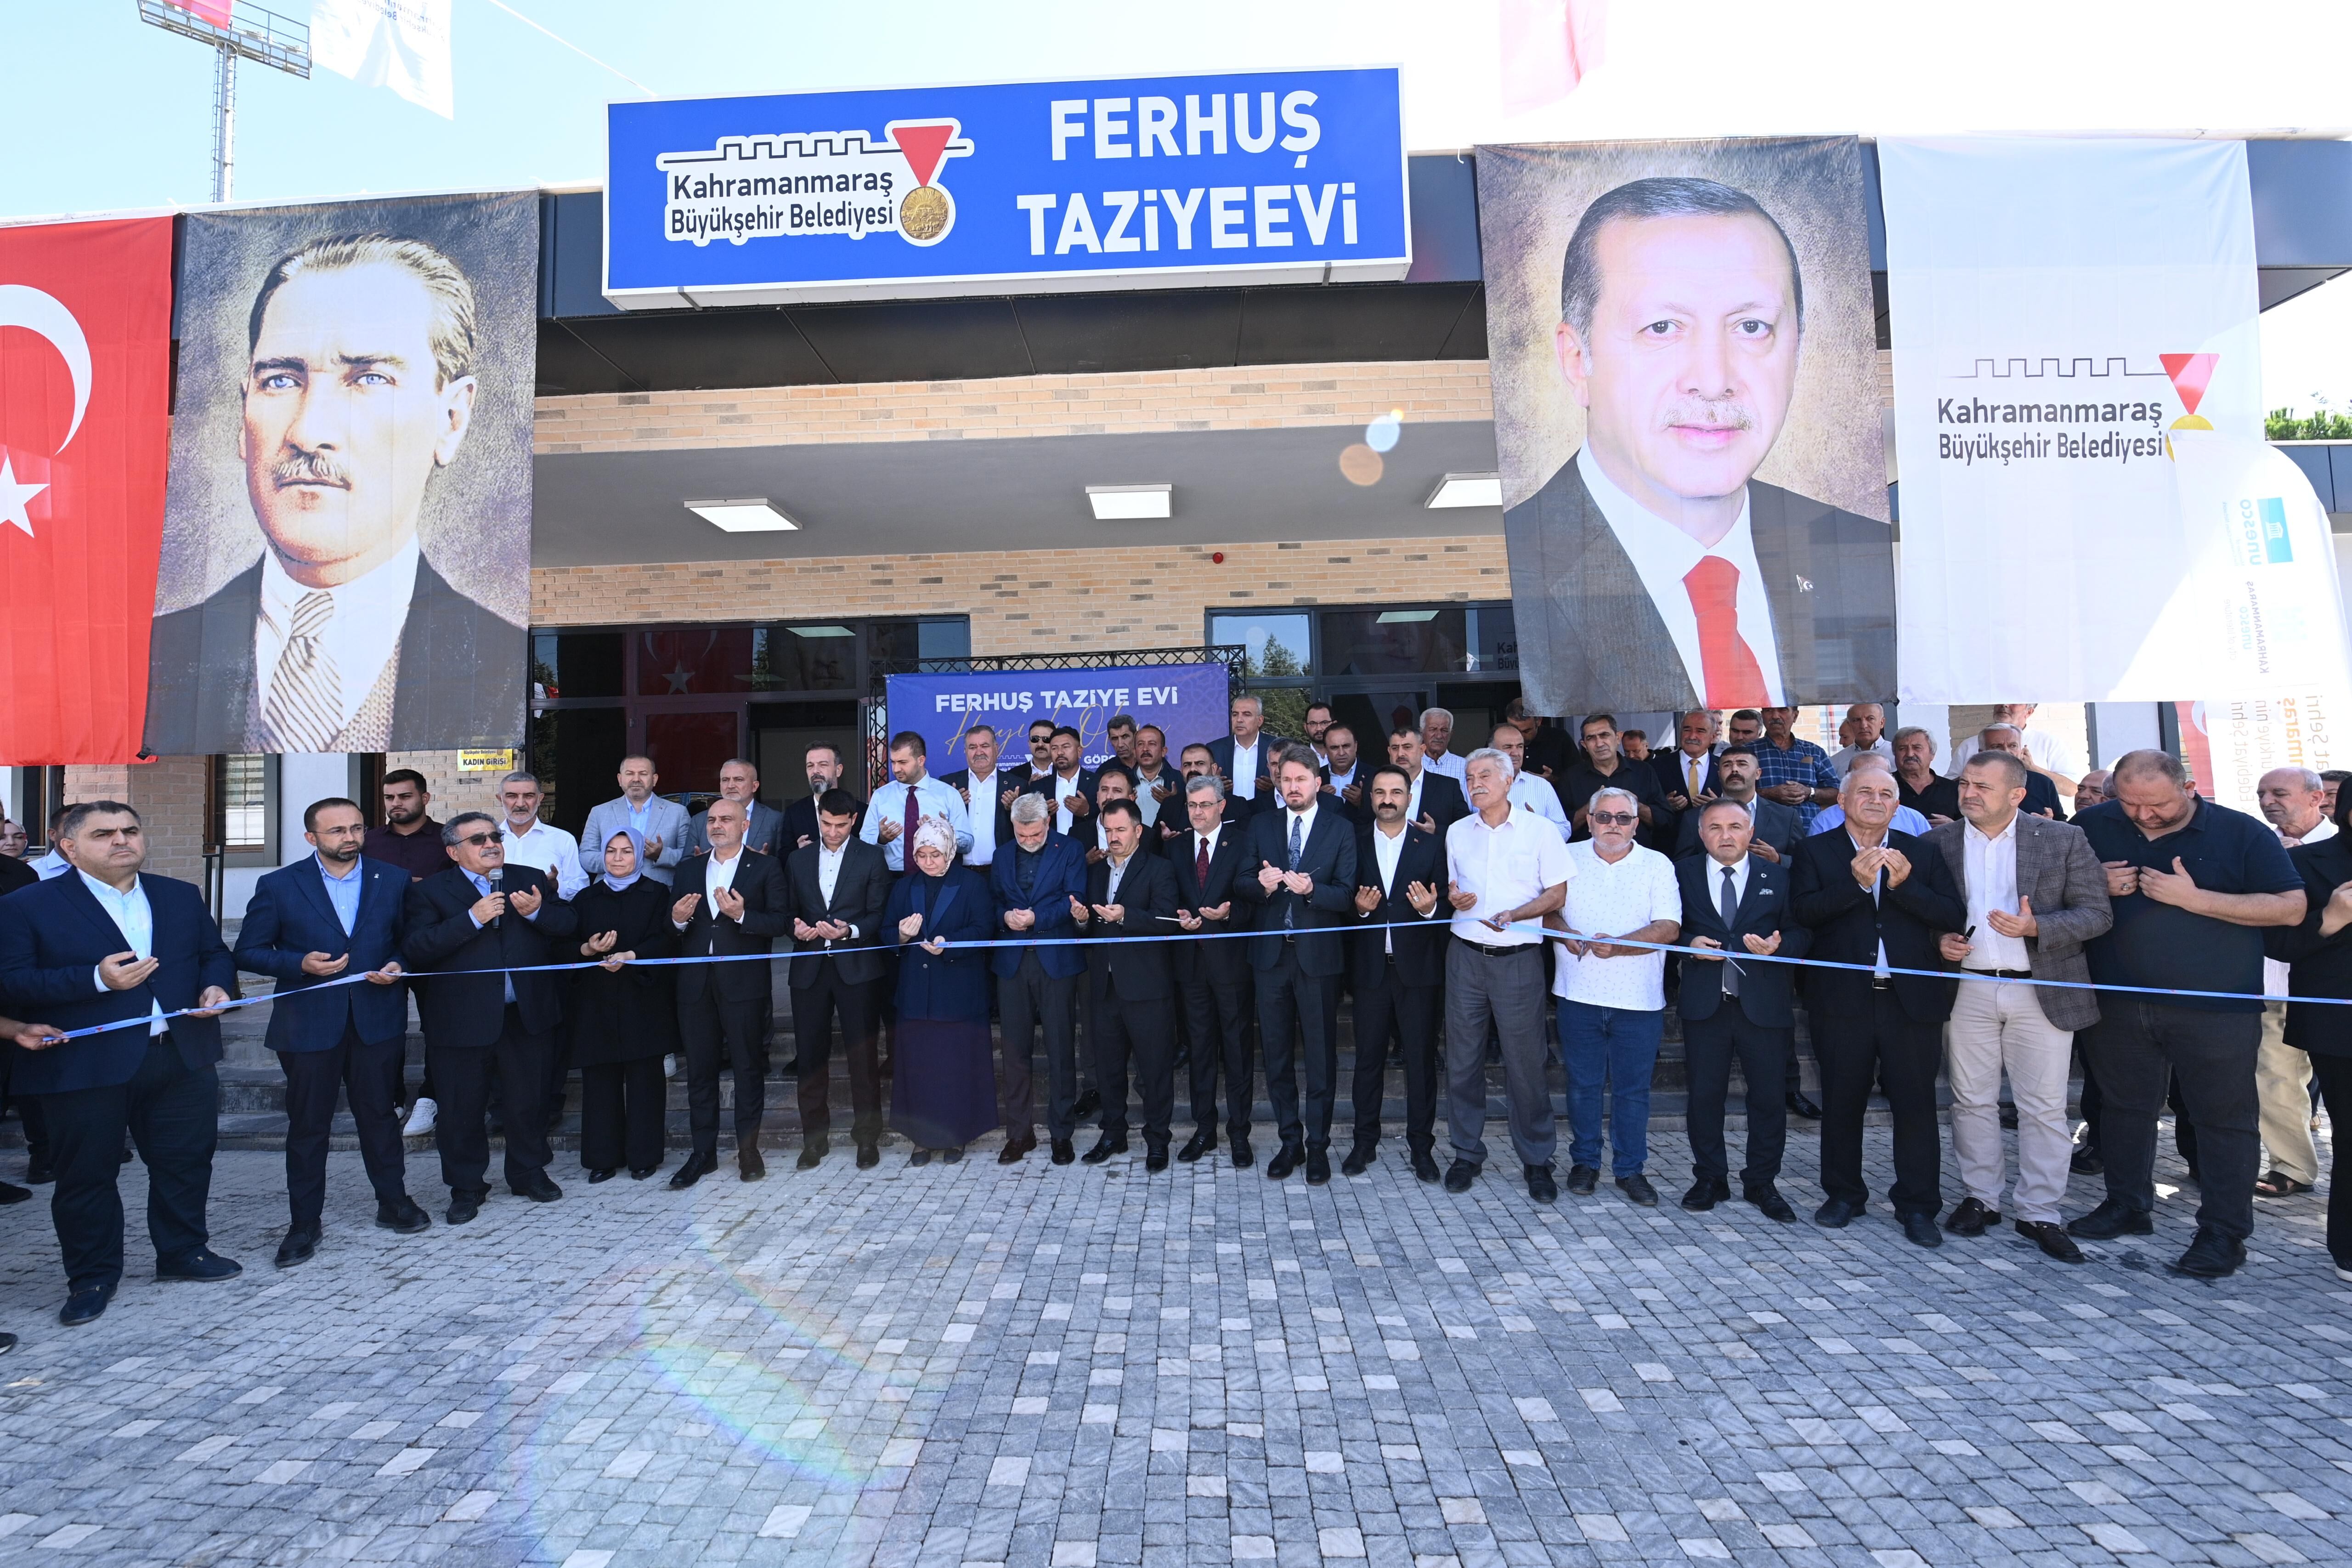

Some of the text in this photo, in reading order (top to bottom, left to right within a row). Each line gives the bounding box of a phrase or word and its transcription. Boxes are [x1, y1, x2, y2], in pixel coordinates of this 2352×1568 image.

[1051, 90, 1321, 168] FERHUŞ
[673, 171, 893, 199] Kahramanmaraş
[672, 199, 893, 238] Büyükşehir Belediyesi
[1938, 397, 2162, 428] Kahramanmaraş
[1939, 430, 2162, 466] Büyükşehir Belediyesi
[936, 691, 1033, 713] FERHUŞ
